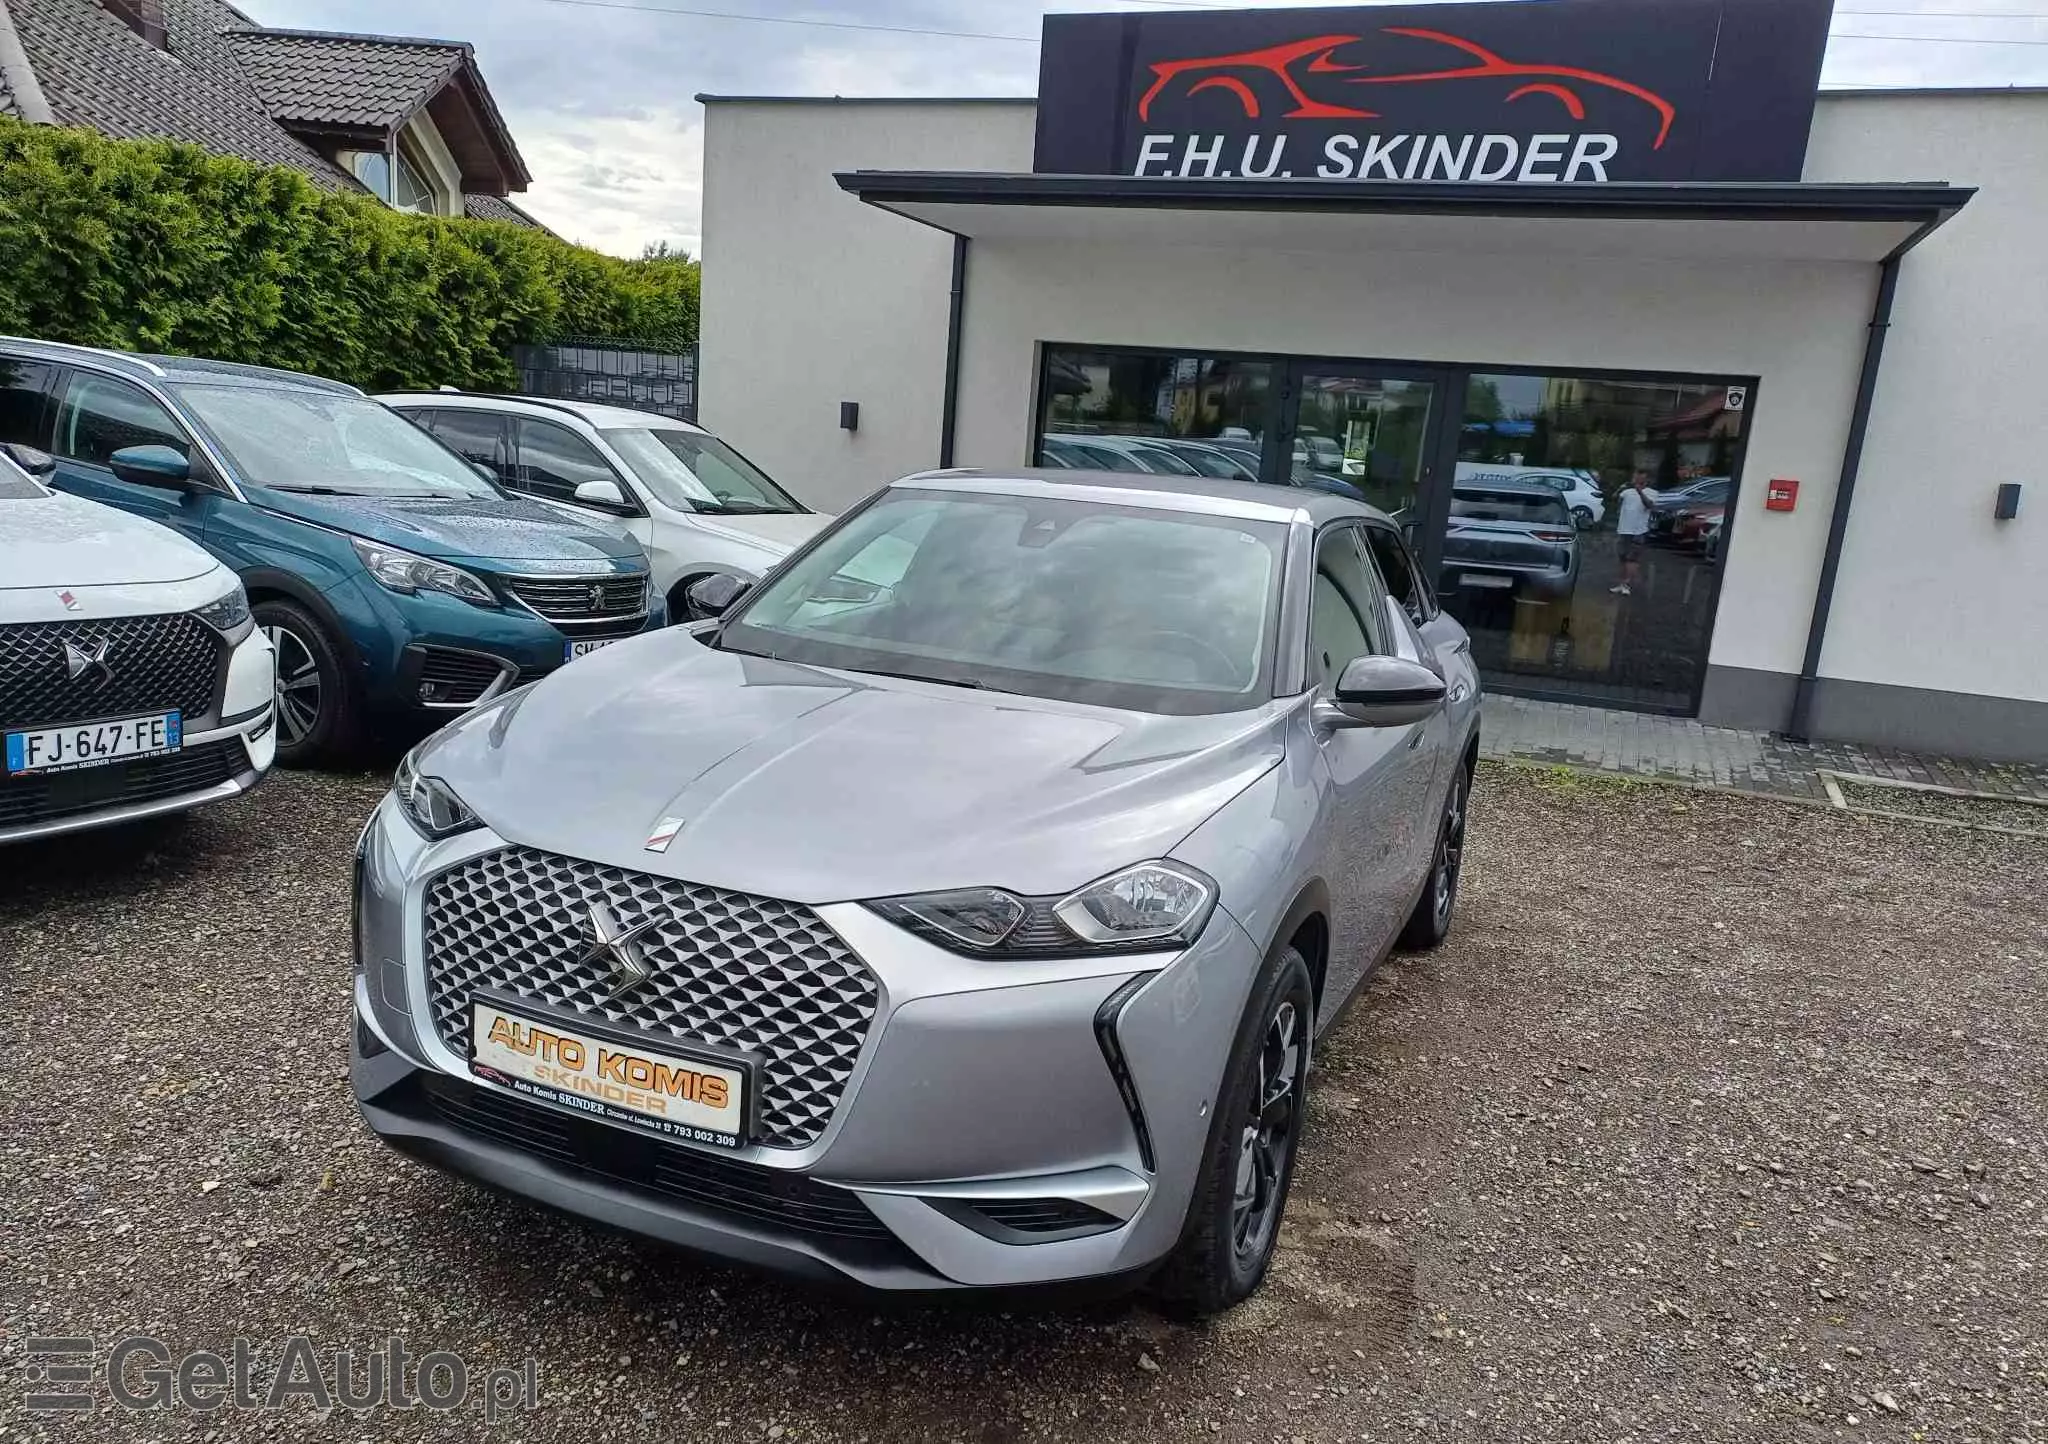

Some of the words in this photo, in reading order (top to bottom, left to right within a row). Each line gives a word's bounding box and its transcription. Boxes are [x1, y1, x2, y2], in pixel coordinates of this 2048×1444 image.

[1133, 134, 1292, 178] F.H.U.
[1316, 132, 1618, 183] SKINDER
[28, 720, 164, 766] FJ-647-FE
[487, 1016, 586, 1072] AUTO
[597, 1048, 729, 1109] KOMIS
[514, 1079, 532, 1093] Auto
[533, 1085, 557, 1101] Komis
[558, 1092, 606, 1116] SKINDER
[673, 1124, 692, 1138] 793
[694, 1130, 714, 1143] 002
[716, 1134, 736, 1147] 309
